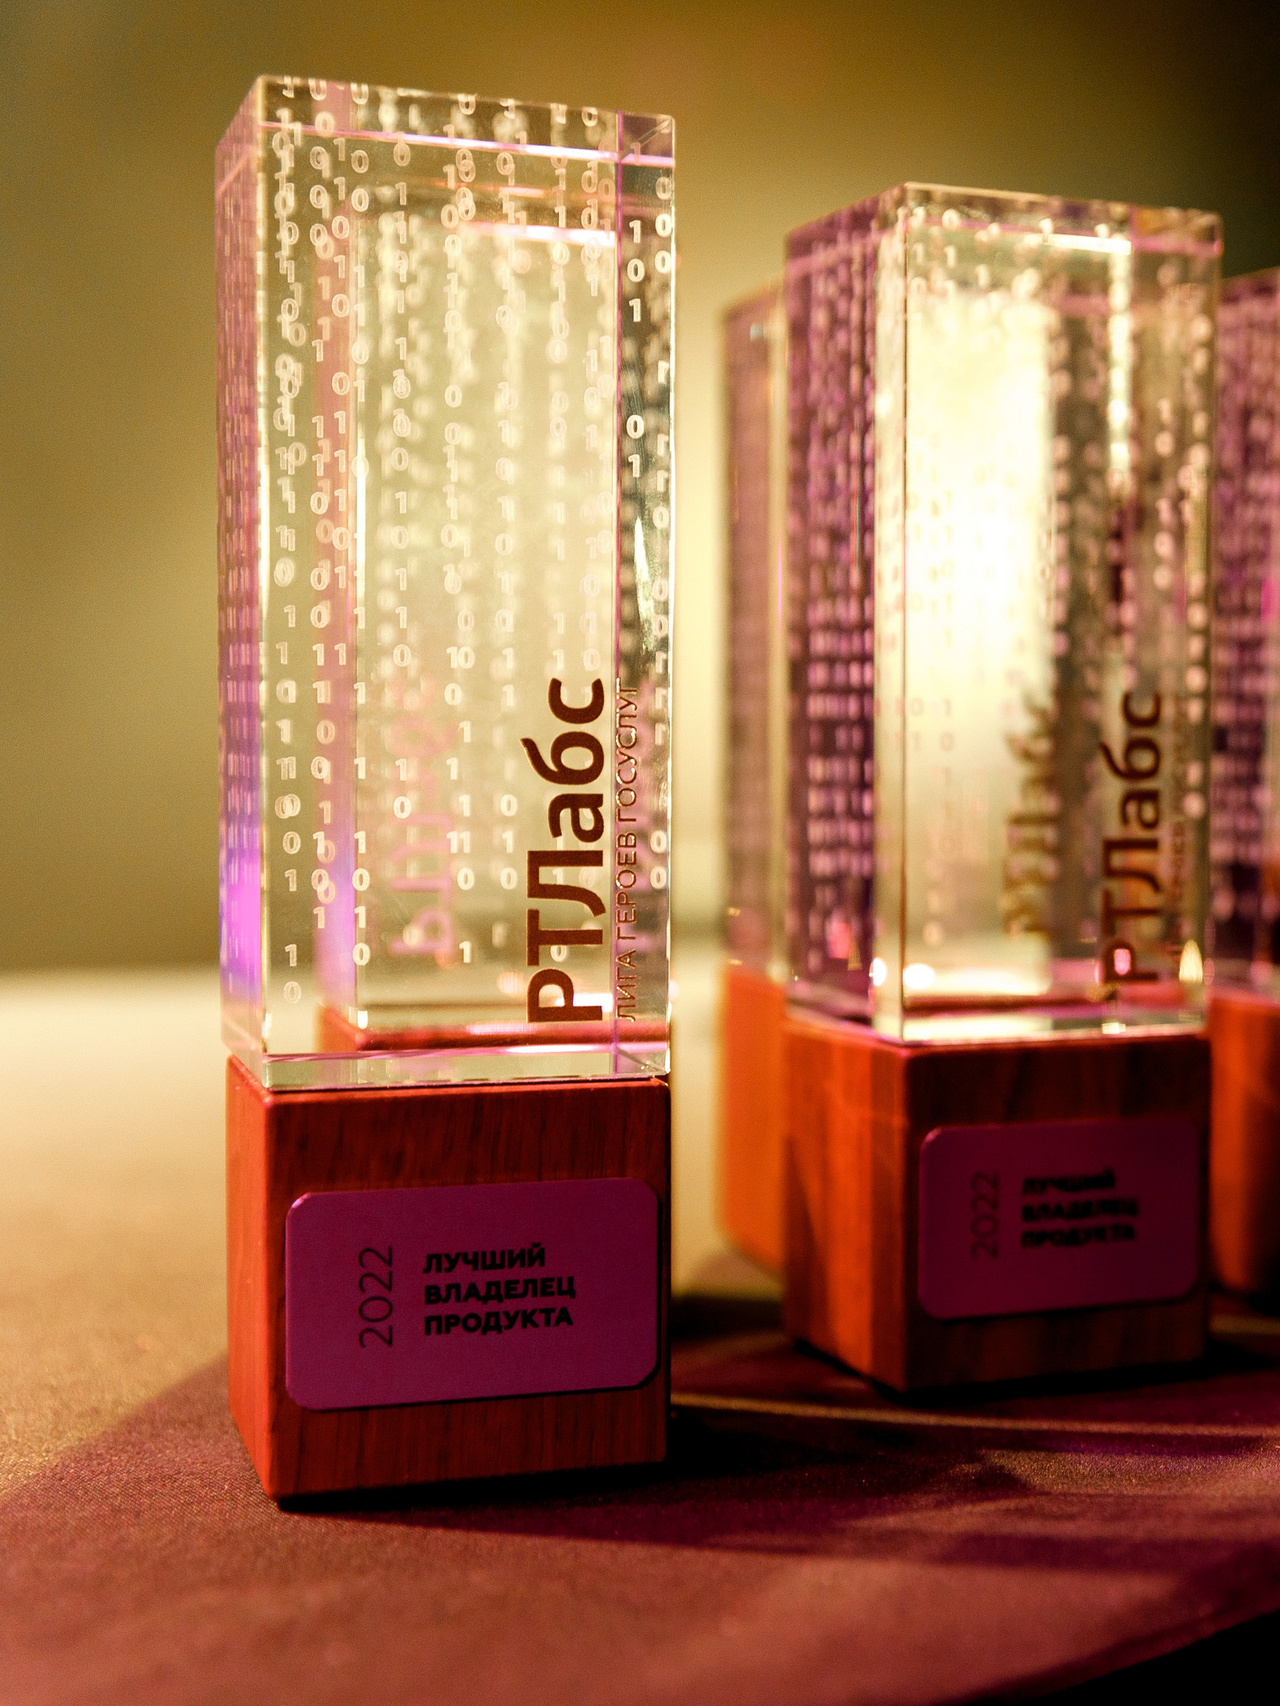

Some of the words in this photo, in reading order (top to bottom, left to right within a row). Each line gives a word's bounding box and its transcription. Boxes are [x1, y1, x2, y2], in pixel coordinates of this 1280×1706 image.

[522, 678, 607, 1023] РТЛабс
[1101, 690, 1162, 984] РТЛабс
[615, 832, 637, 941] ГЕРОЕВ
[615, 948, 637, 1023] ЛИГА
[359, 1246, 393, 1348] 2022
[423, 1242, 546, 1274] ЛУЧШИЙ
[424, 1276, 576, 1305] ВЛАДЕЛЕЦ
[424, 1307, 574, 1336] ПРОДУКТА
